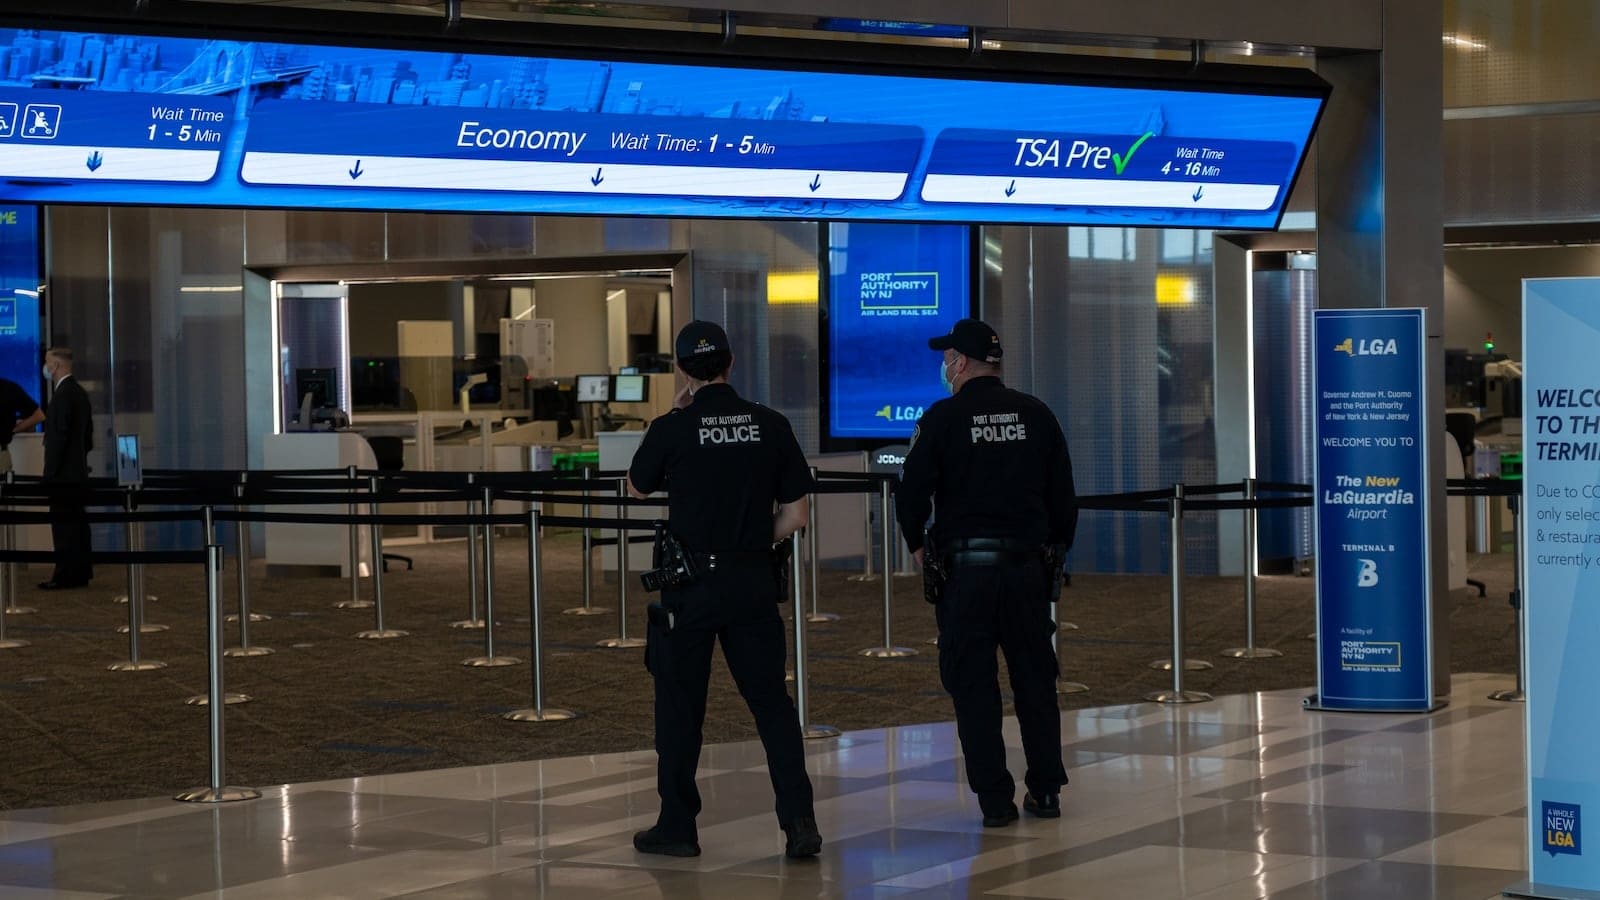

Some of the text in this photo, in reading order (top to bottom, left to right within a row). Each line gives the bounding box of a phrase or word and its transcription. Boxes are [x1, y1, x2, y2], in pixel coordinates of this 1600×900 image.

[151, 106, 224, 121] Wait Time
[148, 123, 157, 141] 1
[178, 125, 192, 141] 5
[194, 129, 221, 142] Min
[457, 121, 587, 157] Economy
[611, 132, 649, 150] Wait
[656, 134, 702, 152] Time:
[709, 134, 719, 153] 1
[738, 135, 753, 154] 5
[753, 143, 776, 155] Min
[1014, 138, 1111, 169] TSA Pre
[1176, 147, 1225, 160] Wait Time
[1161, 161, 1170, 175] 4
[1184, 162, 1201, 176] 16
[1202, 166, 1220, 177] Min
[861, 273, 892, 282] PORT
[861, 281, 929, 290] AUTHORITY
[861, 290, 893, 299] NY NJ
[1358, 339, 1398, 355] LGA
[1323, 391, 1350, 399] Governor
[1351, 391, 1376, 399] Andrew
[1371, 402, 1403, 411] Authority
[701, 414, 752, 426] PORT AUTHORITY
[973, 413, 1019, 425] PORT AUTHORITY
[1325, 412, 1332, 420] of
[1386, 413, 1410, 421] Jersey
[1536, 416, 1563, 434] TO
[699, 425, 761, 445] POLICE
[971, 424, 1026, 443] POLICE
[1323, 437, 1414, 447] WELCOME YOU TO
[1536, 442, 1600, 461] TERMI
[1336, 475, 1400, 487] The New
[1324, 489, 1414, 505] LaGuardia
[1537, 484, 1561, 498] Due
[1564, 486, 1578, 498] to
[1346, 508, 1388, 521] Airport
[1537, 507, 1562, 523] only
[1536, 529, 1545, 542] &
[1342, 544, 1386, 552] TERMINAL
[1537, 552, 1591, 569] currently
[1358, 559, 1379, 587] B
[1553, 809, 1574, 818] WHOLE
[1547, 817, 1574, 831] NEW
[1547, 830, 1575, 848] LGA
